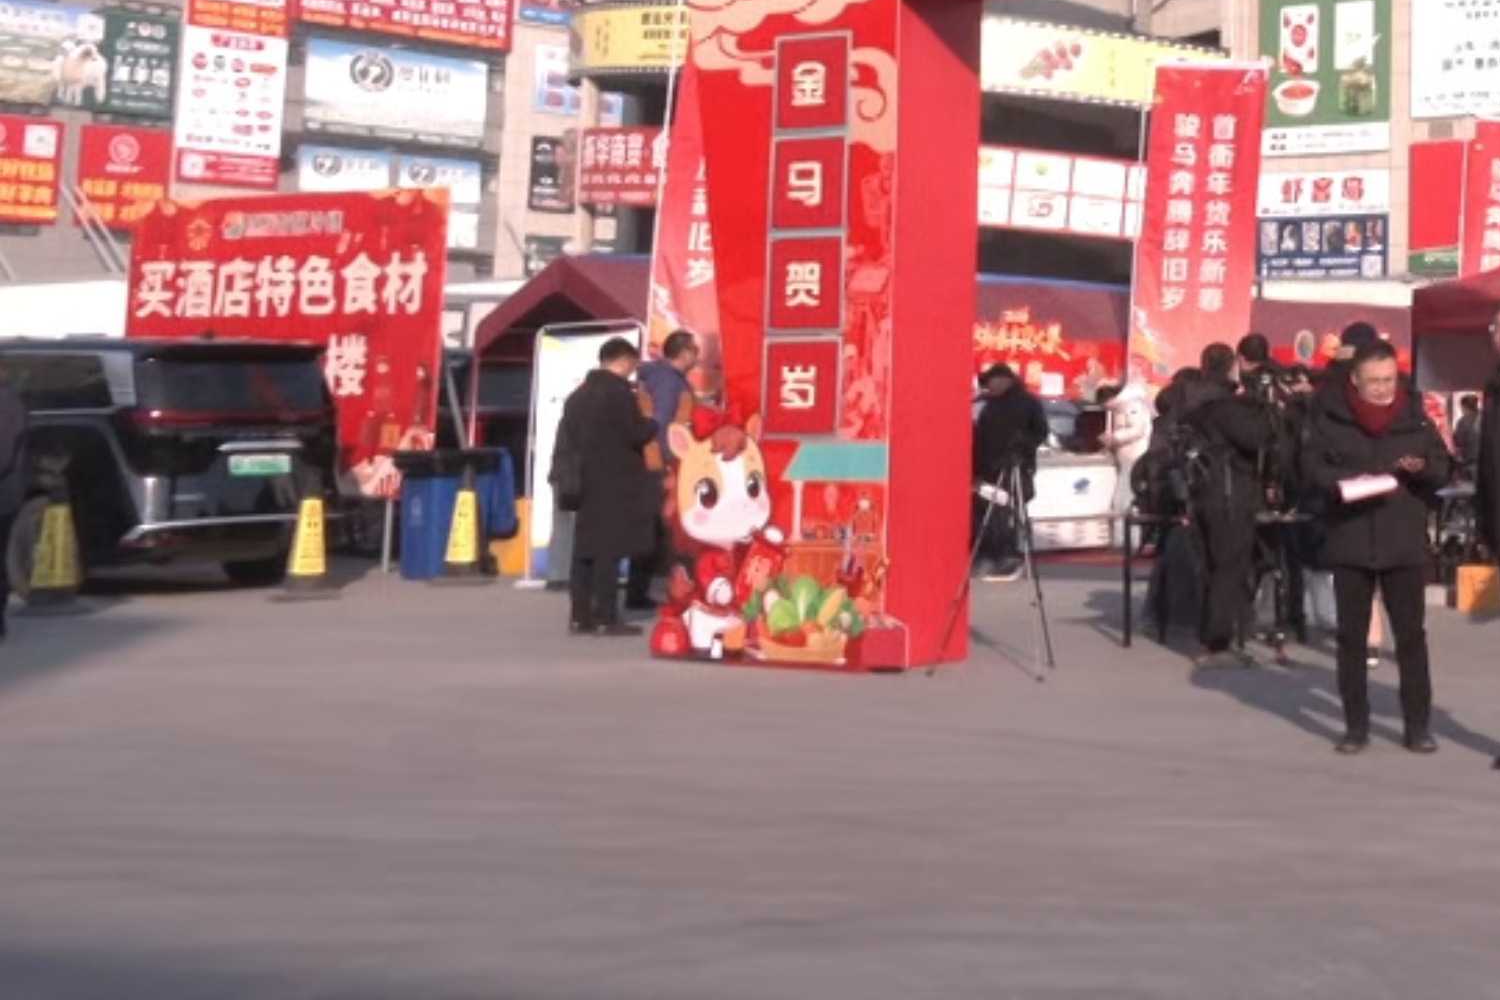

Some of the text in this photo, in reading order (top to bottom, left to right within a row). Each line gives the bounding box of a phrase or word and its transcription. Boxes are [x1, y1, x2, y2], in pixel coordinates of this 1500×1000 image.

[135, 251, 428, 318] 买酒店特色食材
[780, 61, 826, 411] 金马贺岁
[1161, 113, 1199, 312] 骏马奔腾辞旧岁
[1197, 115, 1236, 312] 首衡年货乐新春
